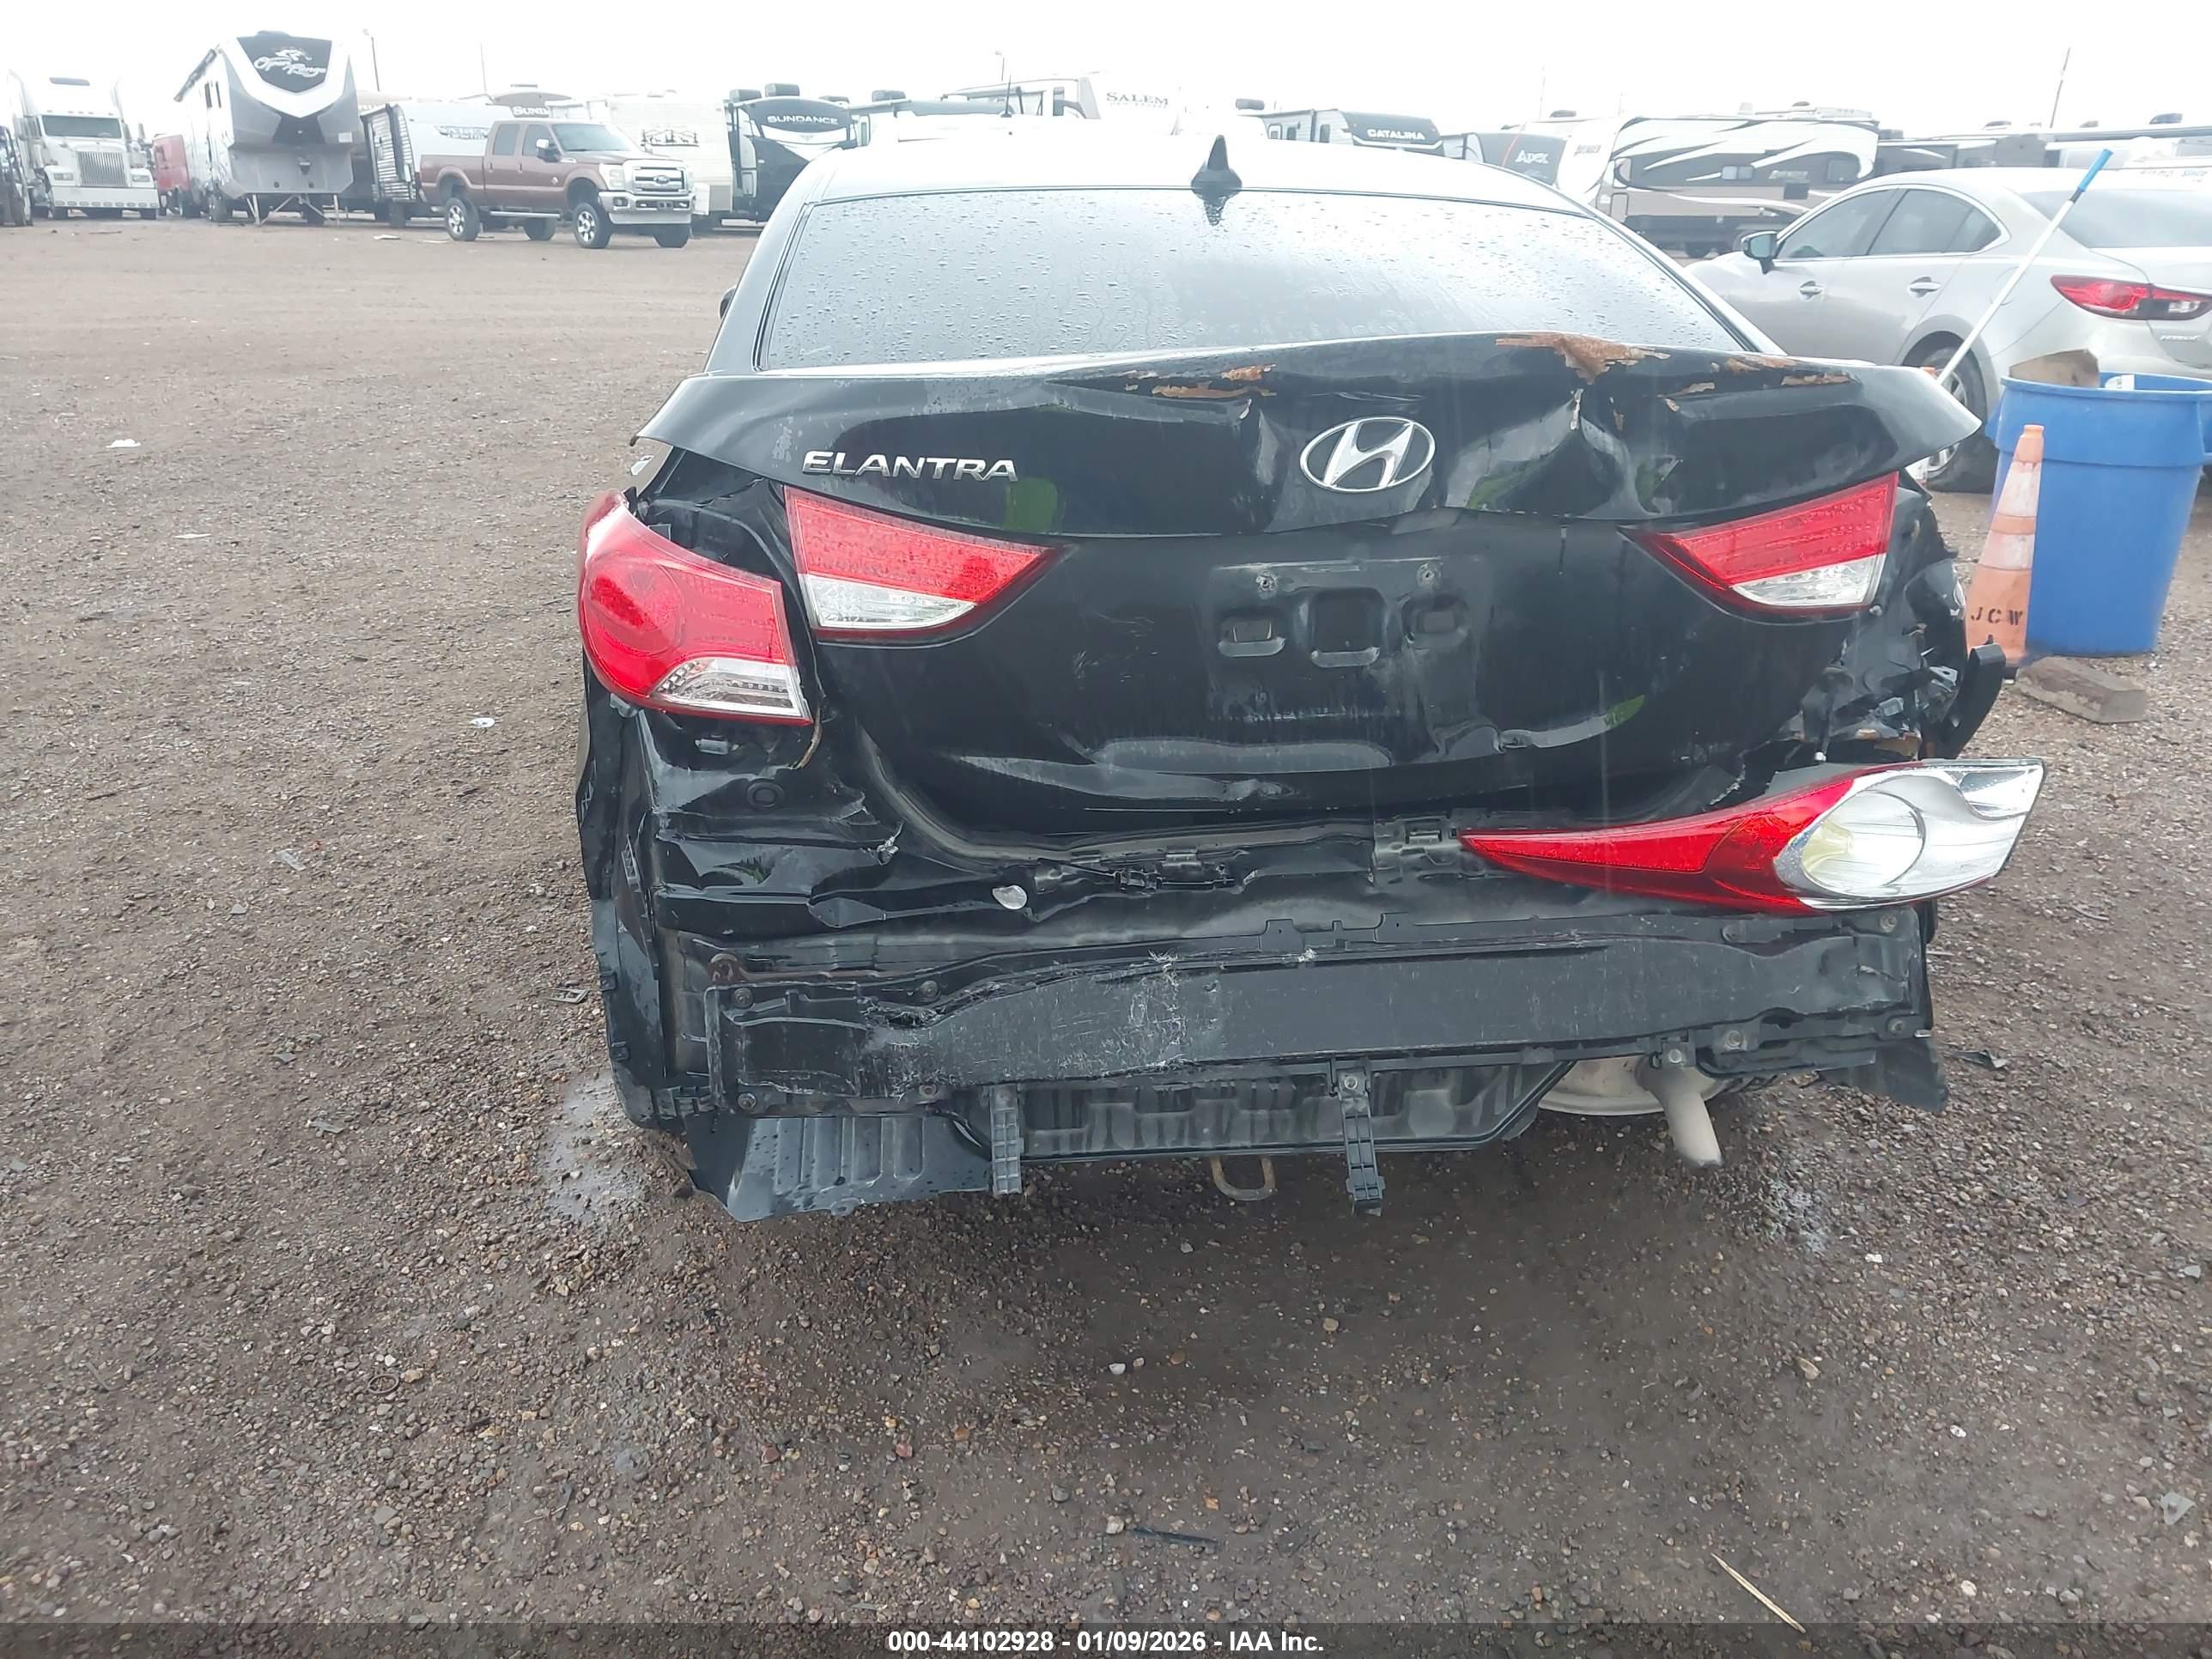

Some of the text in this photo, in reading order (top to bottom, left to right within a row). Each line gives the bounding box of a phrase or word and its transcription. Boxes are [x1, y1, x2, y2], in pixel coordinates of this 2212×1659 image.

[253, 56, 293, 71] Open
[1106, 91, 1169, 106] SALEM
[766, 114, 839, 125] SUNDANCE
[1366, 128, 1425, 141] CATALINA
[802, 450, 1019, 483] ELANTRA
